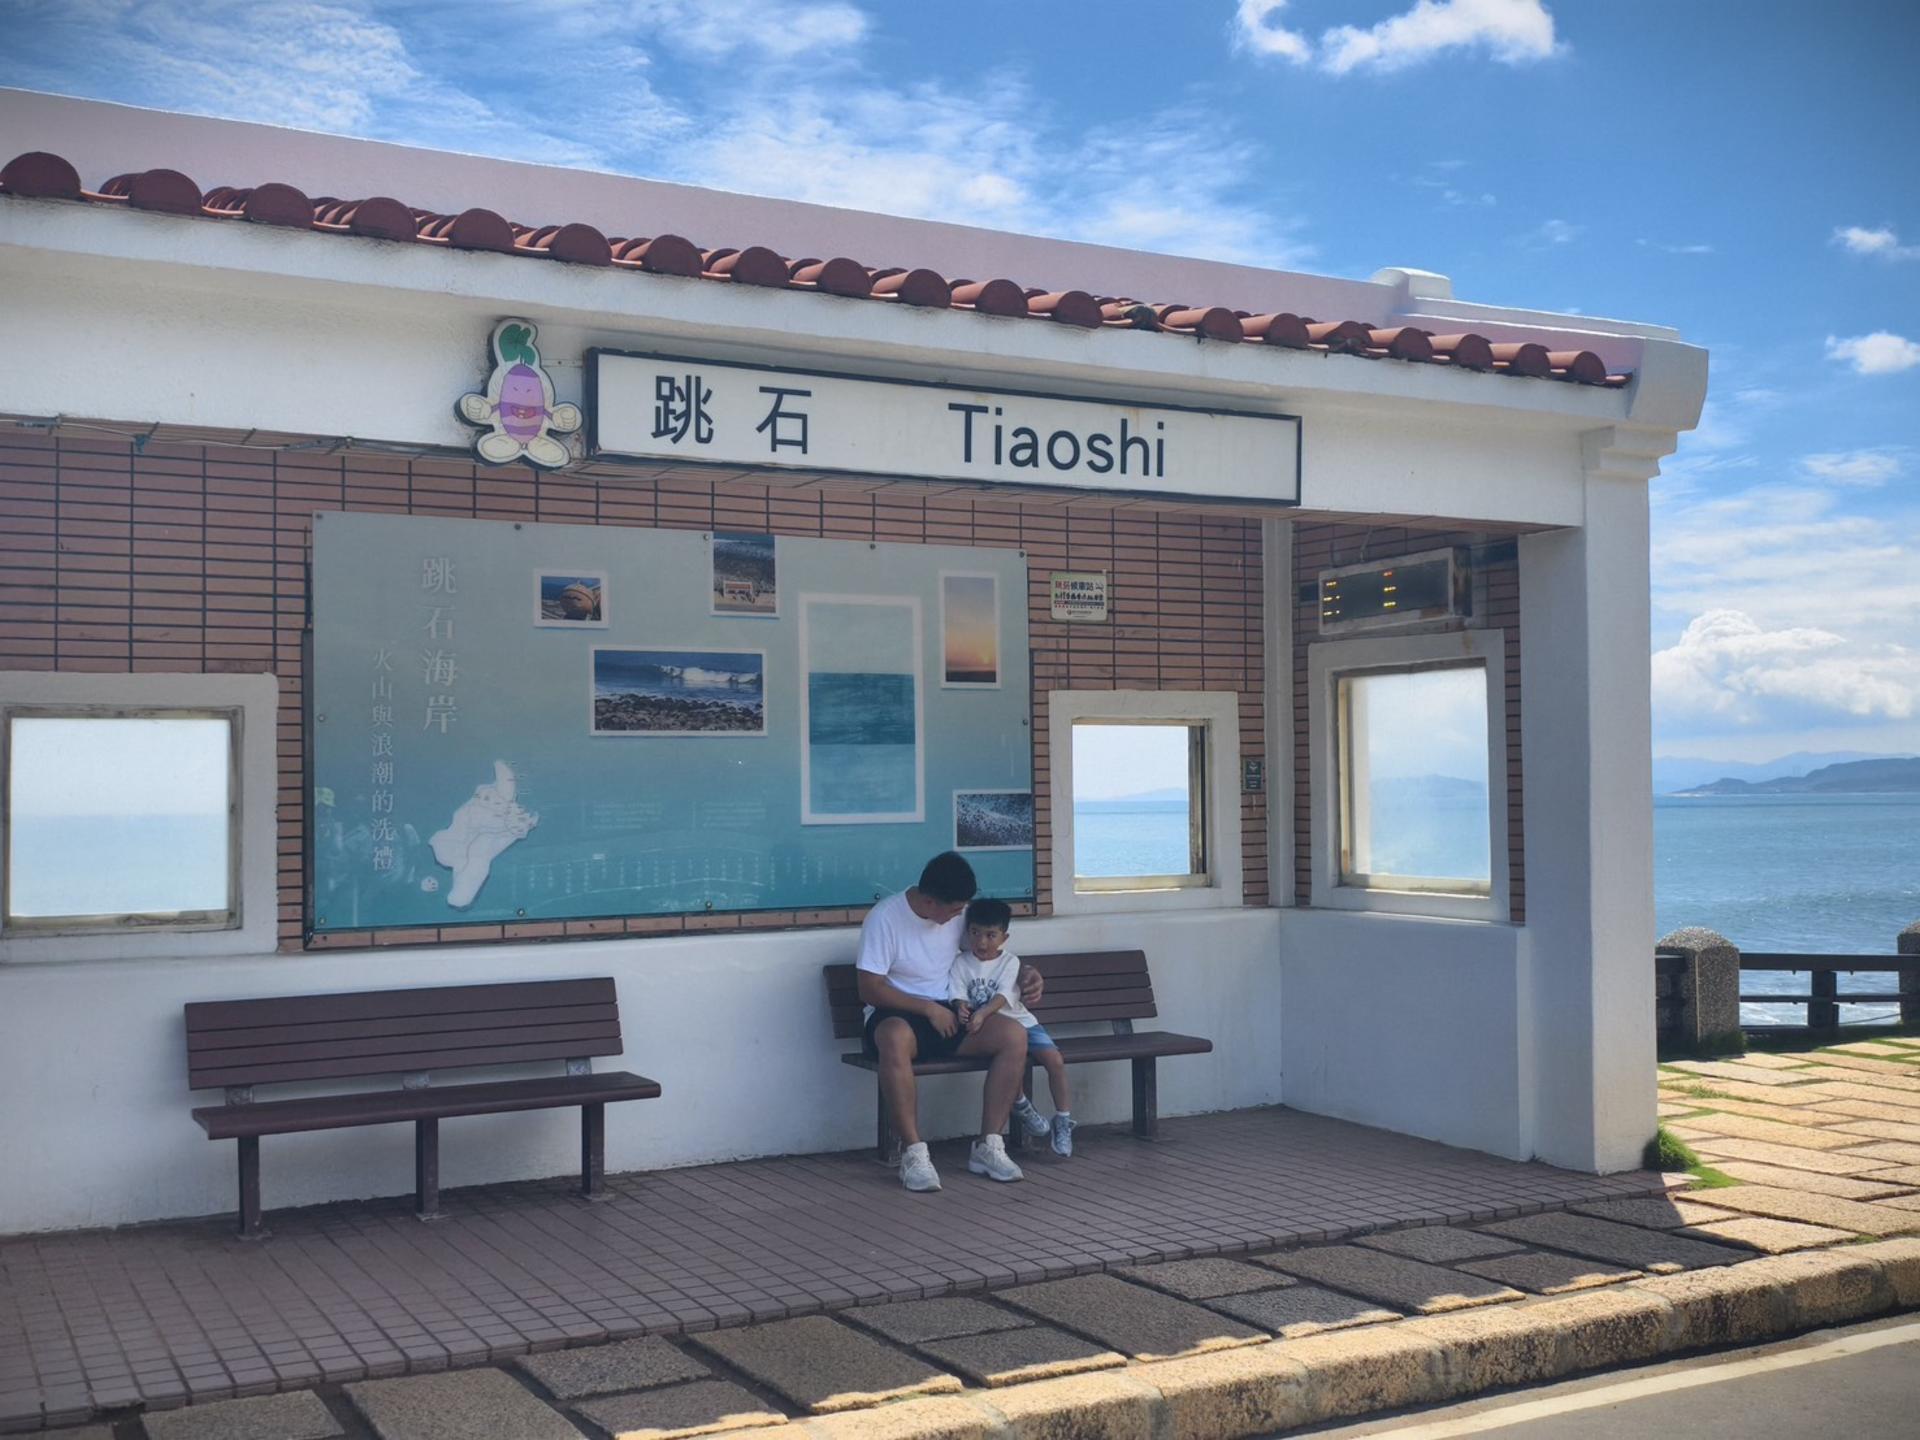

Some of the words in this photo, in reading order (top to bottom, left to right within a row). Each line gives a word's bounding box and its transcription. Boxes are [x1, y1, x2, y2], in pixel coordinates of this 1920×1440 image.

[651, 375, 812, 454] 跳石
[948, 403, 1164, 477] Tiaoshi
[421, 557, 457, 733] 跳石海岸
[371, 648, 394, 871] 火山與浪潮的洗禮
